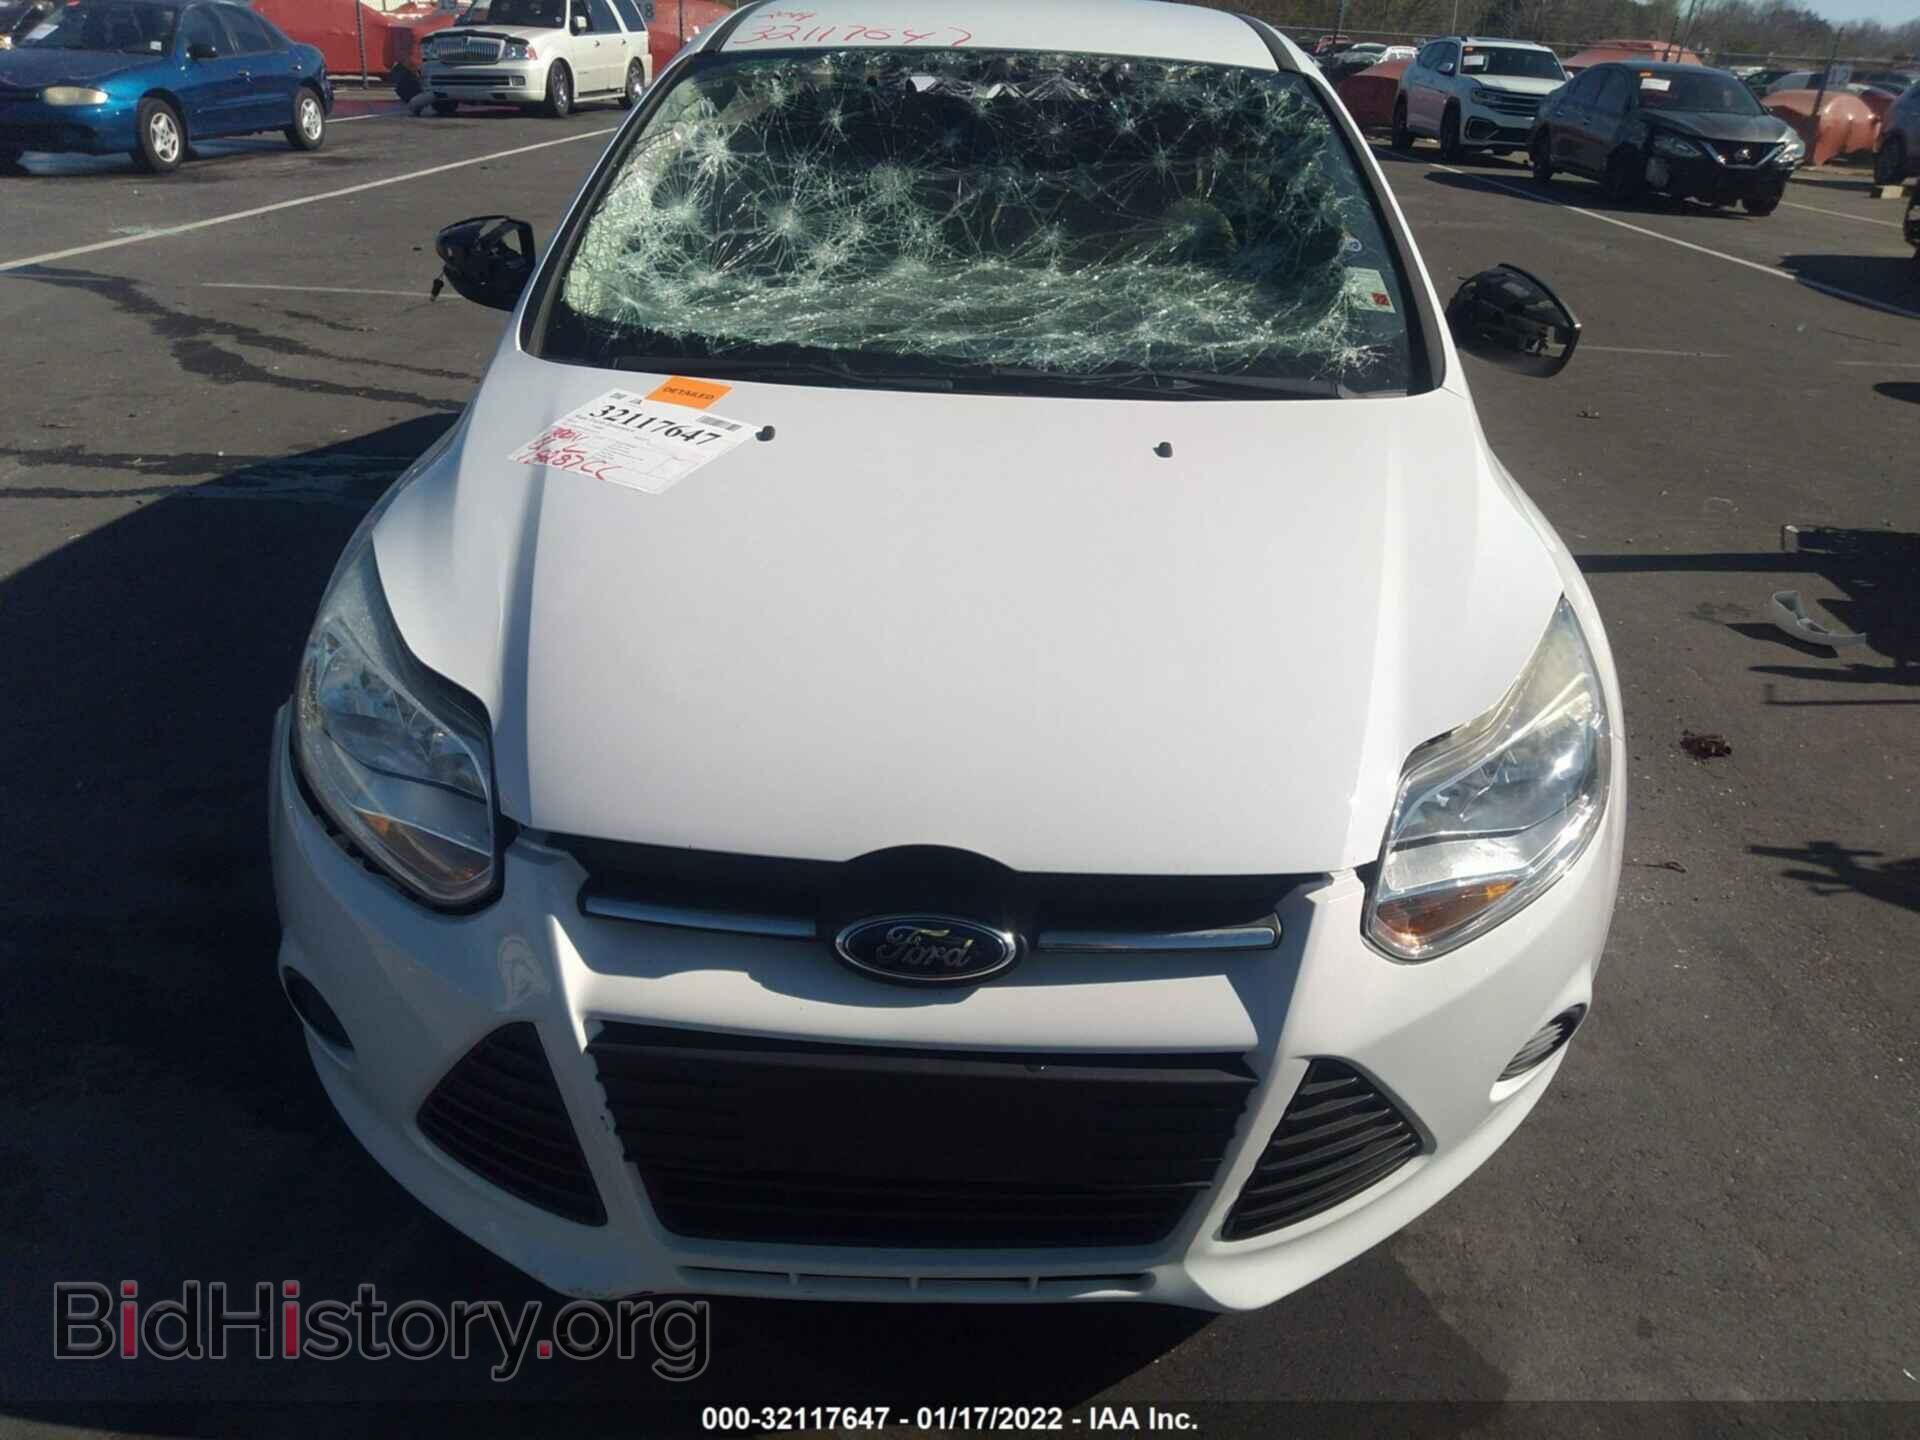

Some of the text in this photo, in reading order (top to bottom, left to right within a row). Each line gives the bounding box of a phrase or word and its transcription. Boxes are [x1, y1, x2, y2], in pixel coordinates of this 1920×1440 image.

[662, 386, 715, 400] DETAILED
[588, 404, 722, 446] 32117647
[876, 926, 974, 967] Ford
